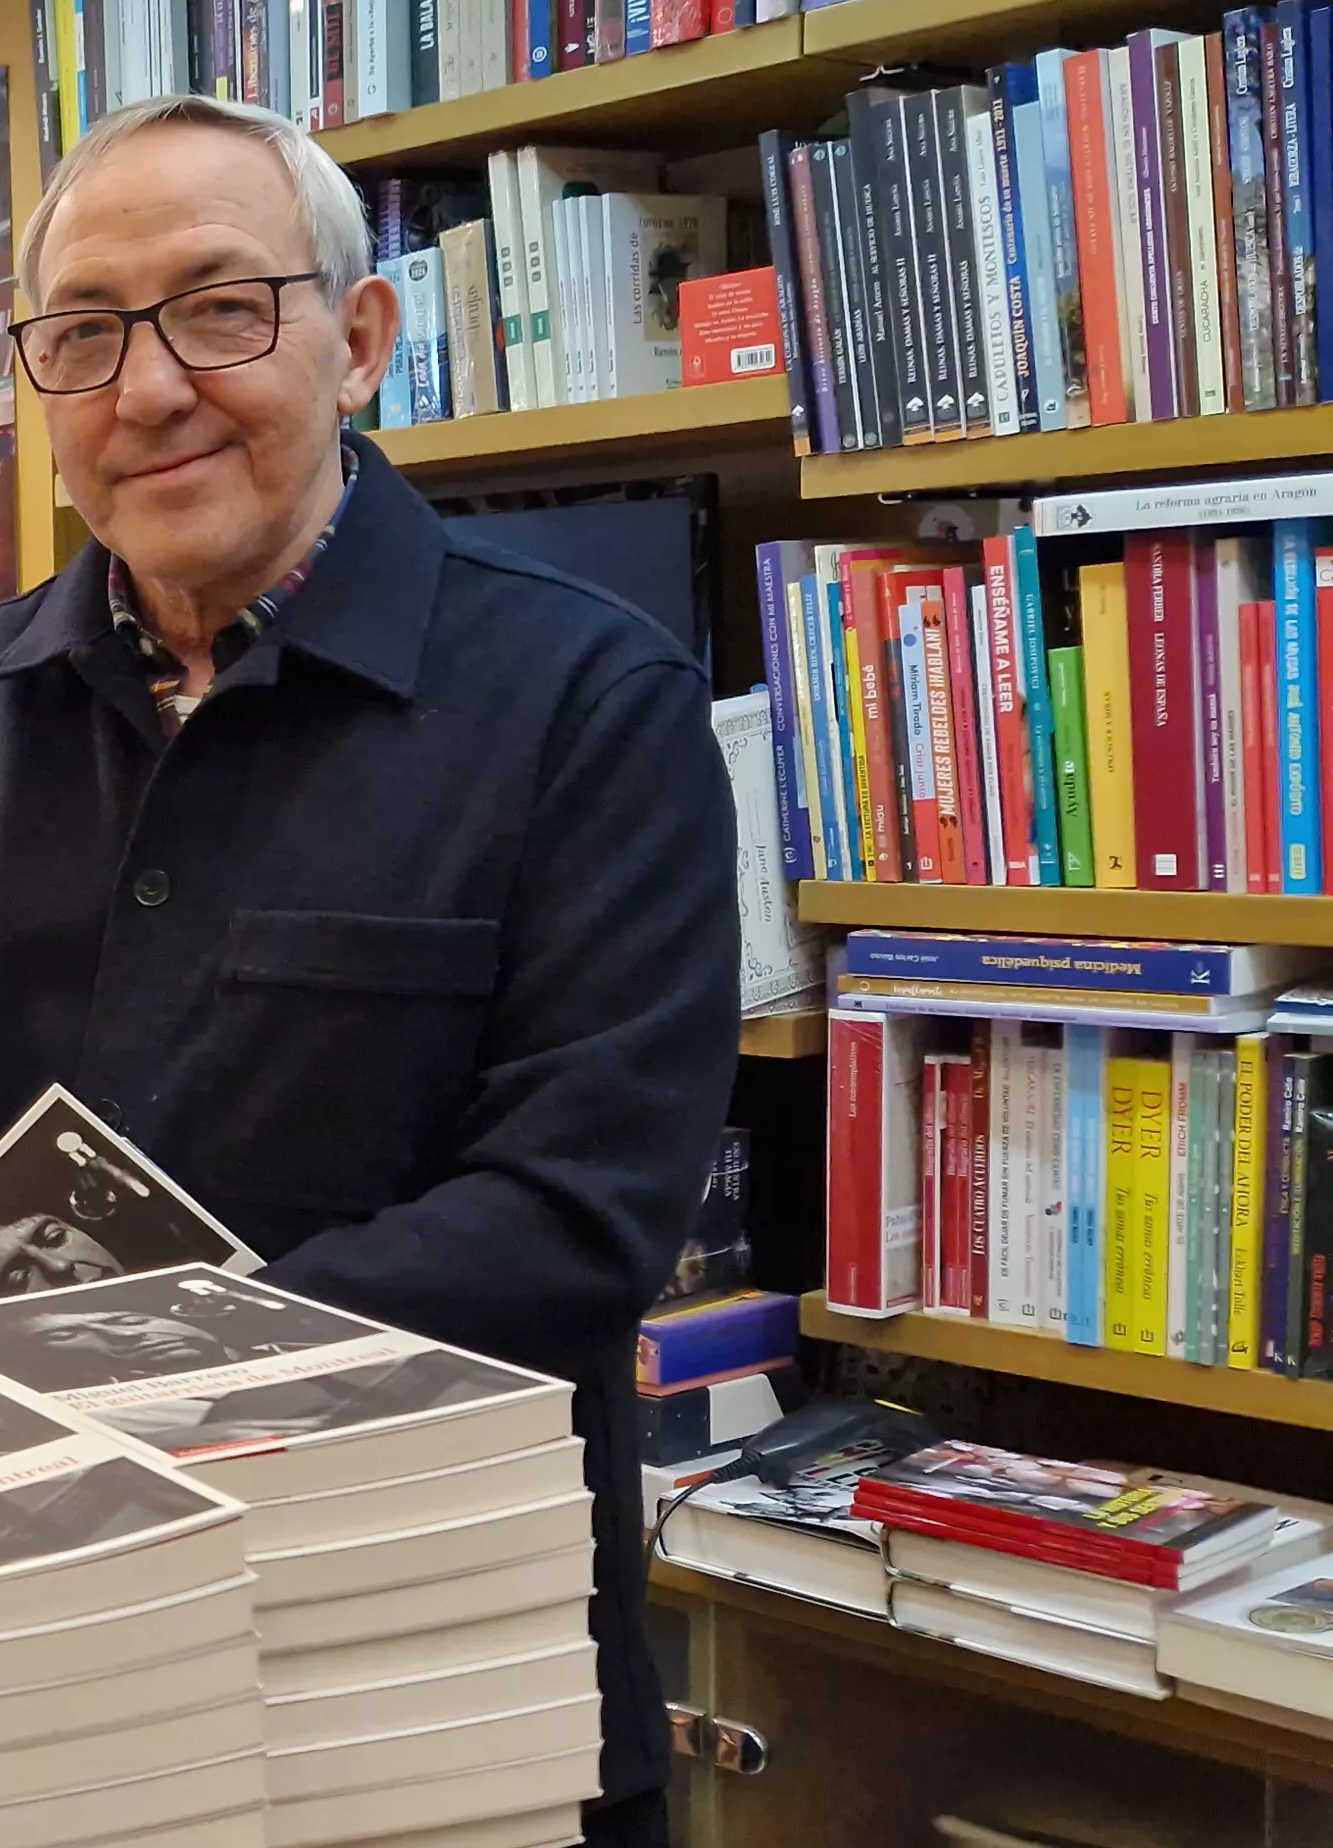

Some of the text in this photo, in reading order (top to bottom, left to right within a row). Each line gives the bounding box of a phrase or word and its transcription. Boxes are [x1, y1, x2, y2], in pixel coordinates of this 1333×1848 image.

[420, 33, 434, 51] LA
[998, 156, 1011, 188] muerte
[1002, 213, 1018, 265] Centenario
[629, 232, 642, 325] Las corridas de
[978, 195, 1009, 402] CAPULETOS Y MONTESCOS
[466, 284, 483, 331] brujas
[875, 310, 885, 343] Manuel
[1009, 275, 1030, 378] JOAQUÍN COSTA
[1136, 486, 1318, 511] La reforma agraria en Aragón
[763, 557, 774, 602] MAESTRA
[1150, 543, 1163, 585] SANDRA
[769, 618, 777, 641] CON
[990, 565, 1014, 714] ENSÉÑAME A LEER
[1154, 632, 1166, 674] LEONAS
[771, 643, 786, 732] CONVERSACIONES
[861, 664, 879, 719] mi bebé
[1156, 689, 1169, 727] ESPAÑA
[931, 691, 949, 753] REBELDES
[935, 755, 953, 817] MUJERES
[778, 789, 792, 842] CATHERINE
[875, 804, 885, 832] miau
[755, 844, 773, 924] Jane Austen
[1073, 958, 1142, 976] Medicina
[847, 1041, 859, 1118] Los contemplativos
[1111, 1086, 1133, 1155] DYER
[1140, 1090, 1162, 1160] DYER
[1176, 1082, 1188, 1157] ERICH FROMM
[1282, 1103, 1293, 1131] Ramiro
[1294, 1103, 1305, 1134] Ramiro
[1001, 1136, 1011, 1165] FUERZA
[1235, 1060, 1253, 1228] EL PODER DEL AHORA
[972, 1133, 986, 1256] LOS CUATRO ACUERDOS
[1001, 1178, 1010, 1206] FUMAR
[1144, 1192, 1158, 1213] Tus
[1000, 1220, 1009, 1246] DEJAR
[1000, 1247, 1010, 1268] FÁCIL
[1233, 1291, 1247, 1316] Tolle
[53, 1367, 249, 1404] Miguel Barrero
[68, 1346, 397, 1411] El guitarrista de Montreal
